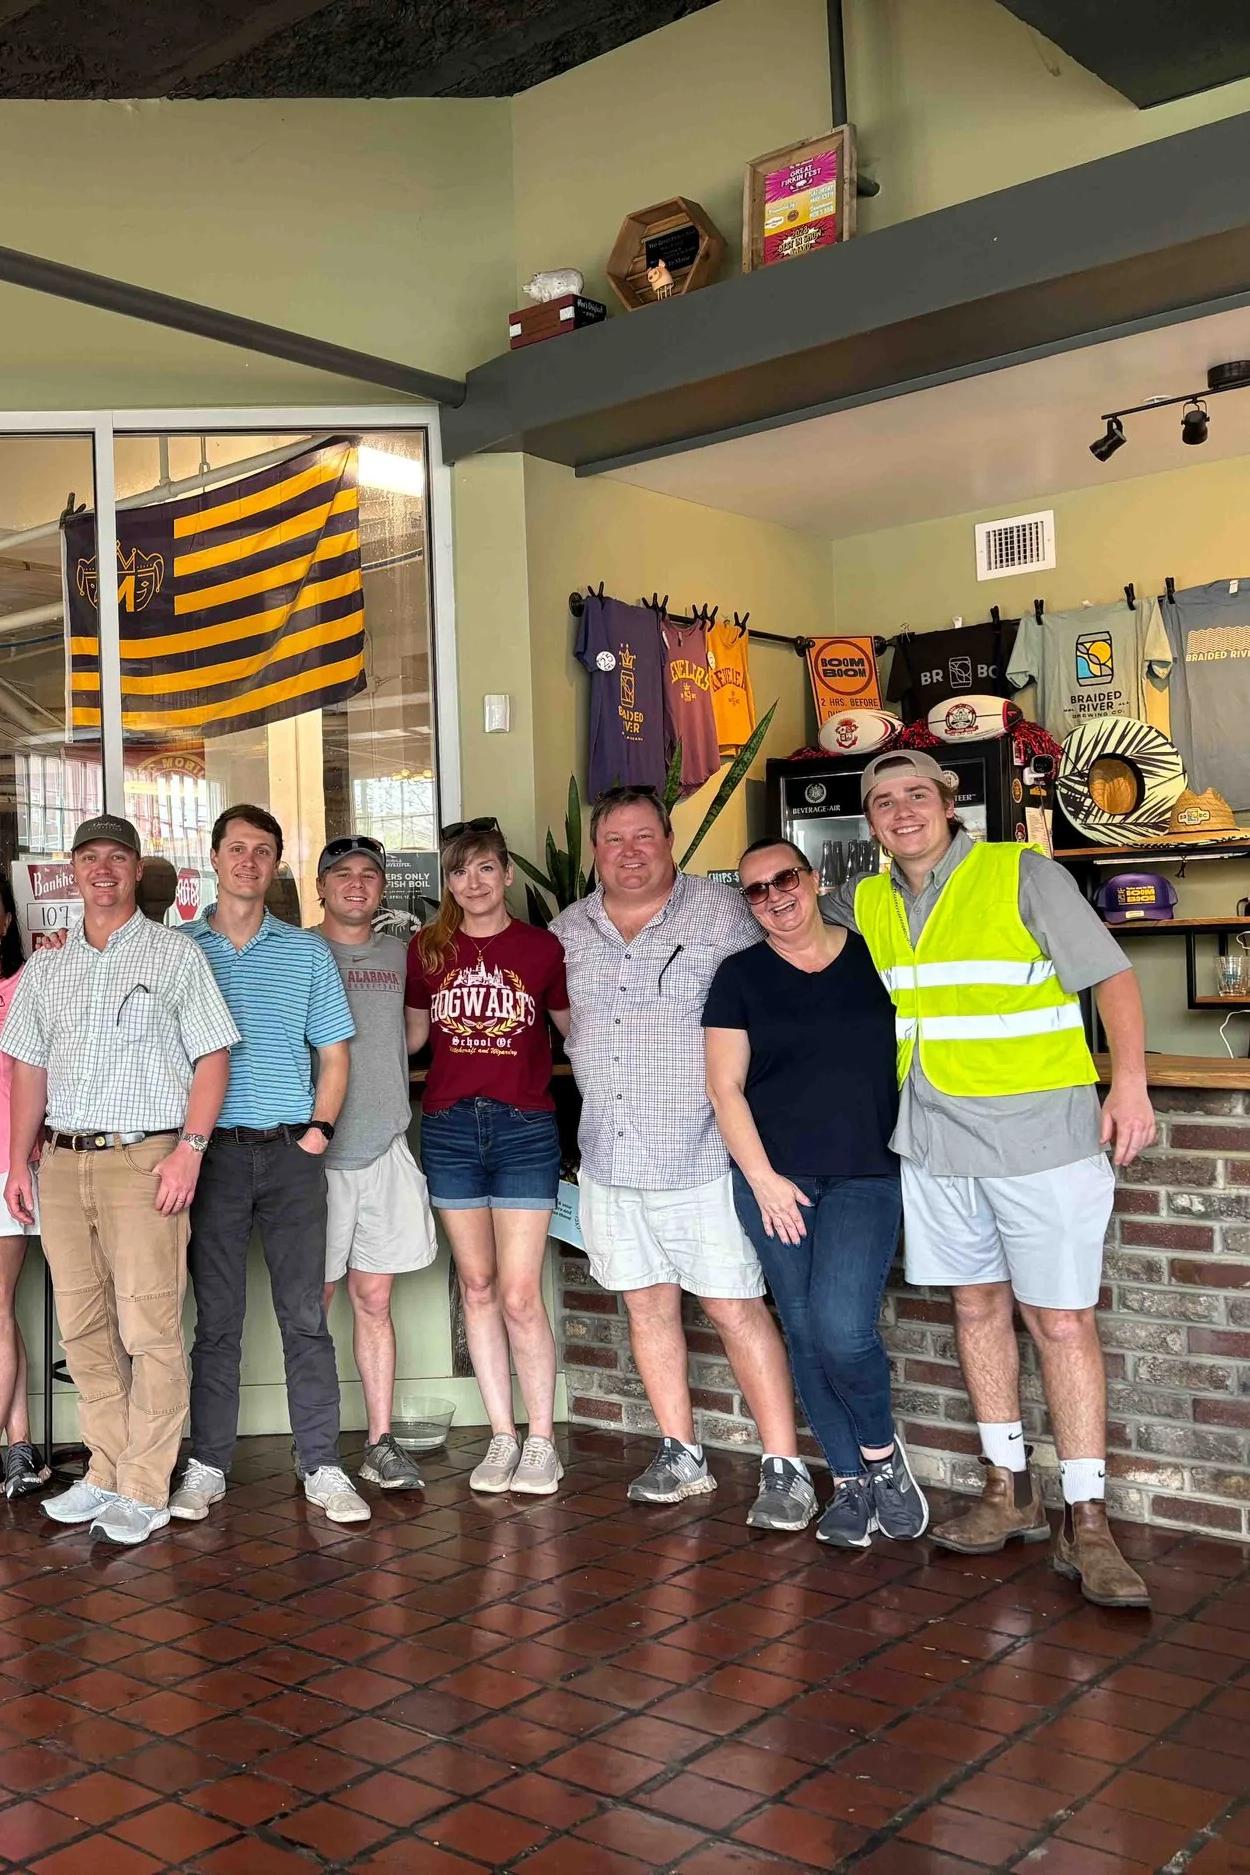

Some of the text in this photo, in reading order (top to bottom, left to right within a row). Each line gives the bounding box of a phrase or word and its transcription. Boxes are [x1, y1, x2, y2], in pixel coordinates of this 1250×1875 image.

[790, 164, 813, 177] GREAT
[782, 168, 822, 187] FIRKIN FEST
[1186, 650, 1250, 662] BRAIDED RIVE
[821, 658, 865, 668] BOOM
[822, 668, 867, 678] BOOM
[920, 670, 944, 686] BR
[821, 698, 879, 707] 2 HRS. BEFORE
[1070, 691, 1122, 705] BRAIDED
[1079, 701, 1114, 712] RIVER
[792, 804, 841, 815] BEVERAGE-AIR
[34, 870, 77, 897] Bankhe
[42, 906, 70, 927] 107
[348, 971, 400, 985] ALABAMA
[430, 988, 536, 1026] HOGWARTS
[452, 1036, 512, 1048] School Of
